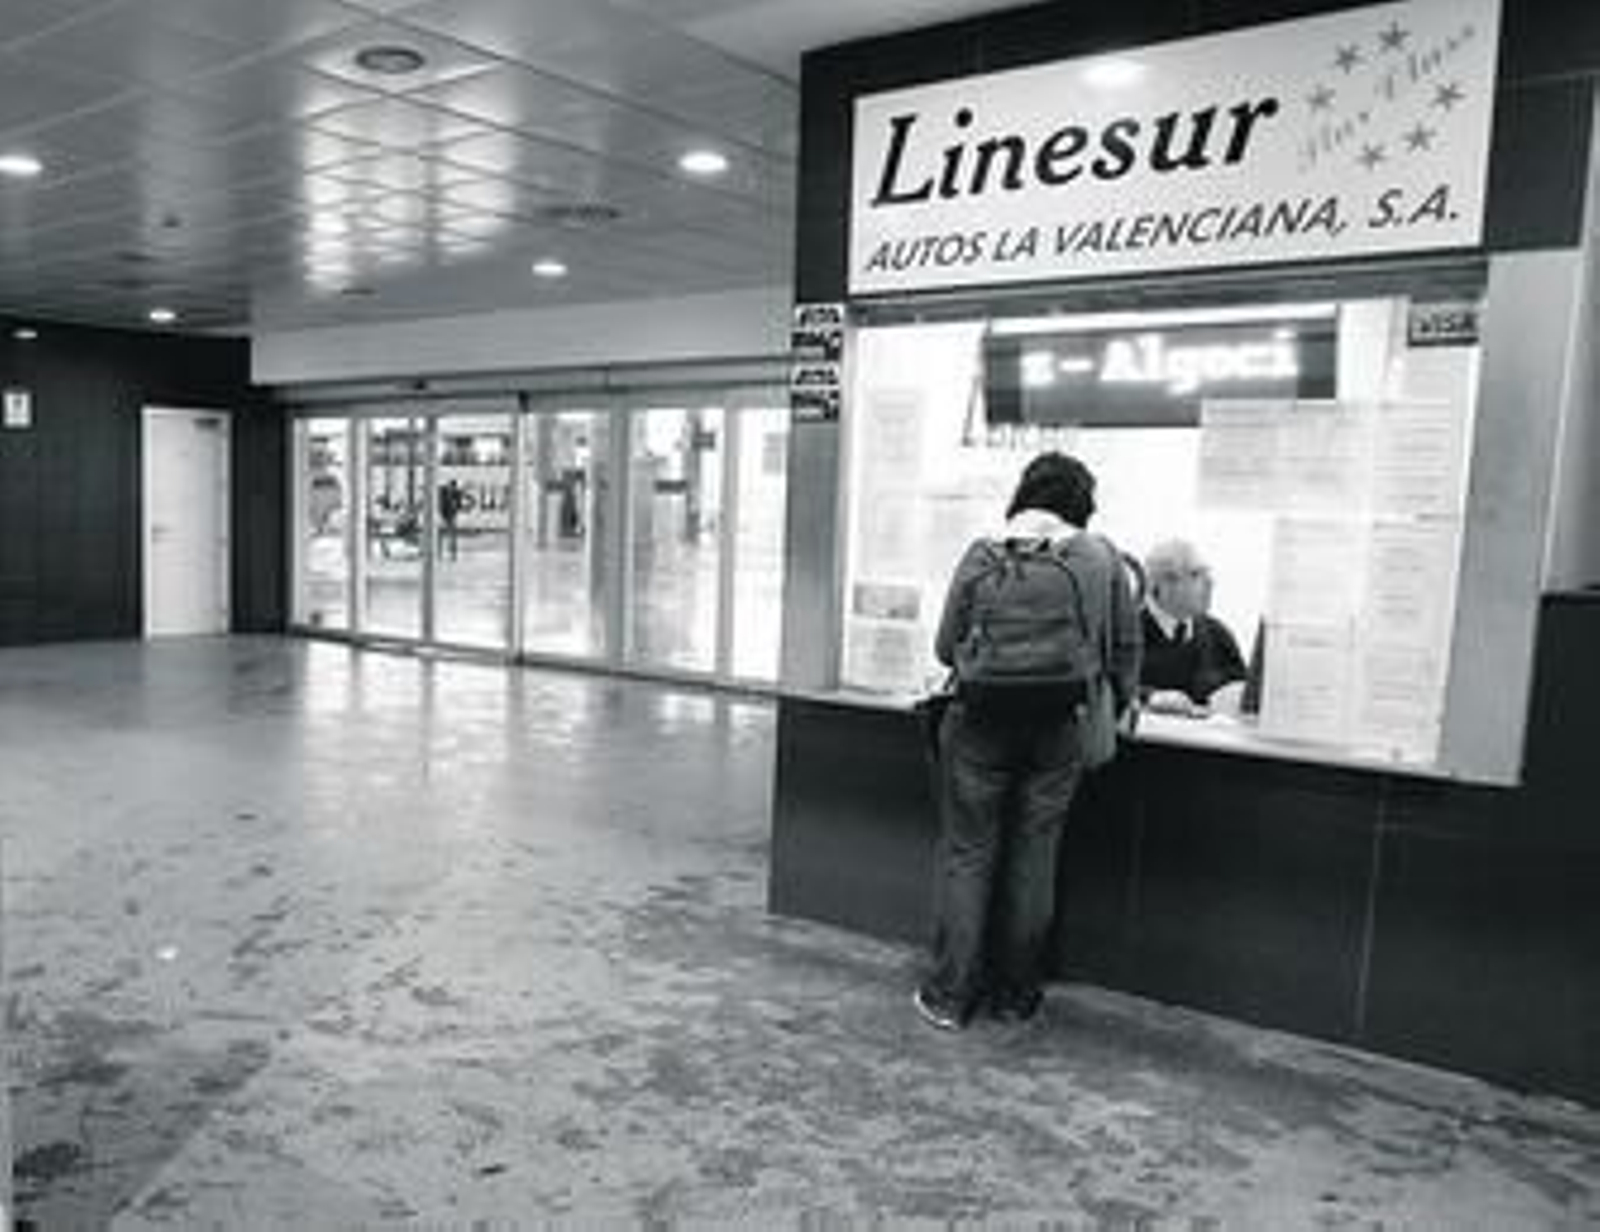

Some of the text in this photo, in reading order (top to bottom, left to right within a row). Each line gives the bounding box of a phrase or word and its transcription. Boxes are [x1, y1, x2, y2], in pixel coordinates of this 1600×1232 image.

[870, 95, 1280, 208] Linesur
[866, 184, 1459, 274] AUTOS LA VALENCIANA, S.A.
